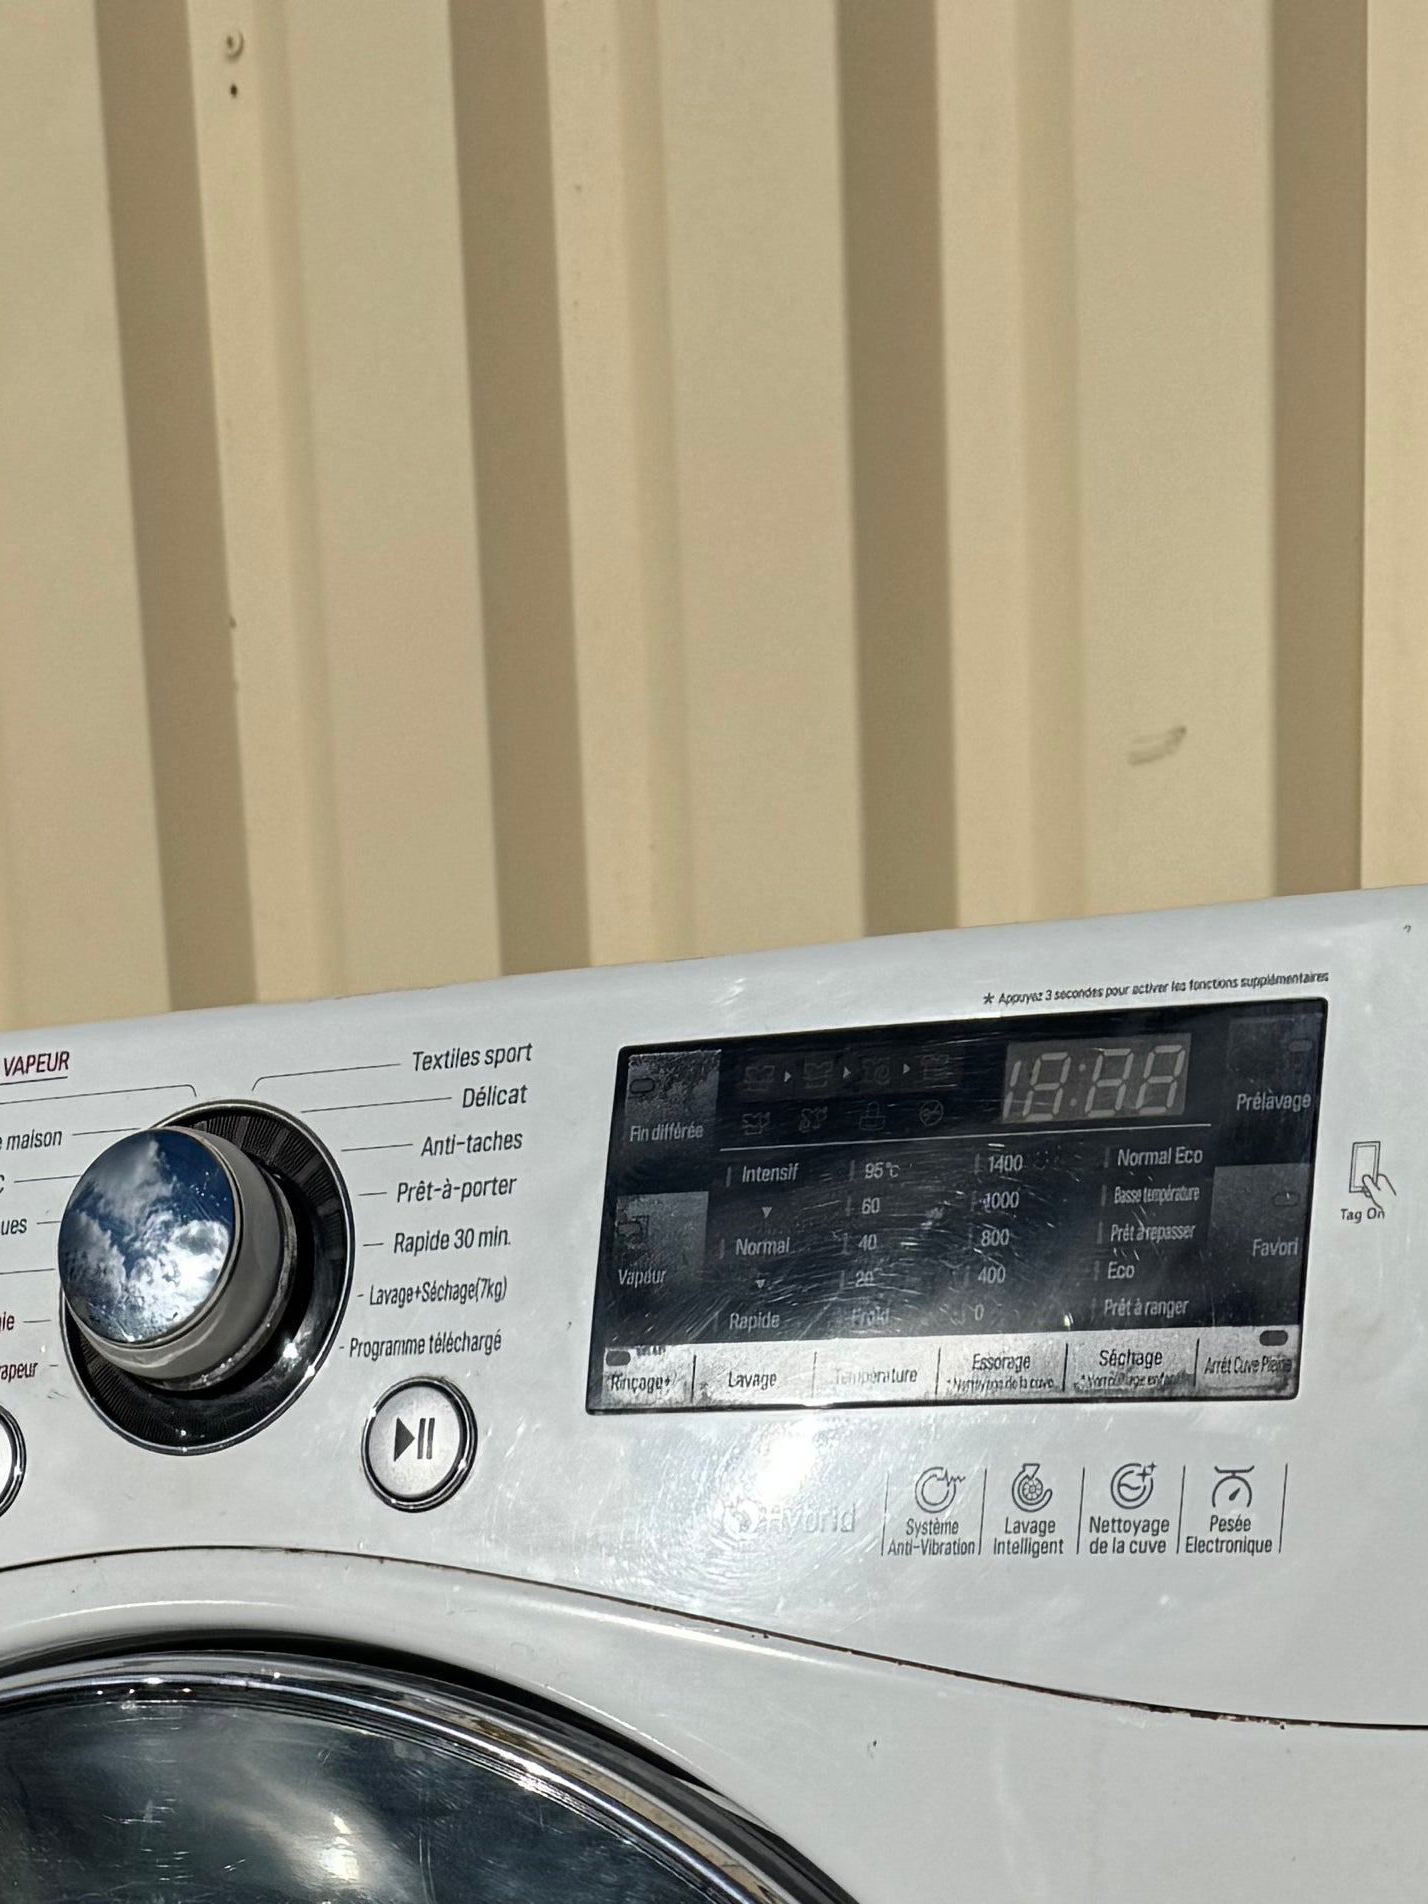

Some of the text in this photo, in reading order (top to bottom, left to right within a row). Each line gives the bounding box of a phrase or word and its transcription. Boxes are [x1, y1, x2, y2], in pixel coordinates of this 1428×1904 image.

[1045, 989, 1052, 1000] 3
[1054, 987, 1103, 1001] secondes
[1105, 985, 1130, 999] pour
[1132, 980, 1169, 995] activer
[1189, 978, 1238, 992] fonctions
[4, 1051, 70, 1077] VAPEUR
[412, 1043, 533, 1071] Textiles sport
[462, 1084, 528, 1108] Délicat
[1236, 1091, 1312, 1112] Prélavage
[7, 1129, 62, 1150] maison
[629, 1121, 704, 1142] Fin différée
[421, 1130, 523, 1157] Anti-taches
[988, 1154, 1023, 1173] 1400
[1117, 1145, 1203, 1167] Normal Eco
[742, 1163, 799, 1183] Intensif
[397, 1176, 517, 1203] Prêt-à-porter
[1114, 1184, 1200, 1205] Basse température
[861, 1198, 880, 1215] 60
[984, 1191, 1020, 1211] 1000
[1340, 1207, 1385, 1224] Tag On
[394, 1225, 511, 1257] Rapide 30 min.
[858, 1234, 877, 1251] 40
[980, 1229, 1010, 1247] 800
[1110, 1223, 1135, 1242] Prêt
[1145, 1224, 1197, 1243] repasser
[735, 1237, 791, 1256] Normal
[1252, 1237, 1299, 1257] Favori
[855, 1271, 874, 1287] 20
[978, 1266, 1006, 1284] 400
[1107, 1261, 1135, 1279] Eco
[974, 1304, 985, 1321] 0
[1104, 1298, 1190, 1319] Prêt à ranger
[729, 1312, 780, 1333] Rapide
[349, 1329, 502, 1362] Programme téléchargé
[972, 1353, 1031, 1373] Essorage
[1099, 1348, 1163, 1369] Séchage
[728, 1371, 777, 1391] Lavage
[906, 1517, 959, 1538] Système
[1004, 1516, 1056, 1537] Lavage
[1089, 1515, 1170, 1537] Nettoyage
[1209, 1514, 1252, 1532] Pesée
[887, 1538, 975, 1556] Anti-Vibration
[993, 1537, 1064, 1558] Intelligent
[1089, 1536, 1167, 1554] de la cuve
[1185, 1535, 1273, 1557] Electronique
